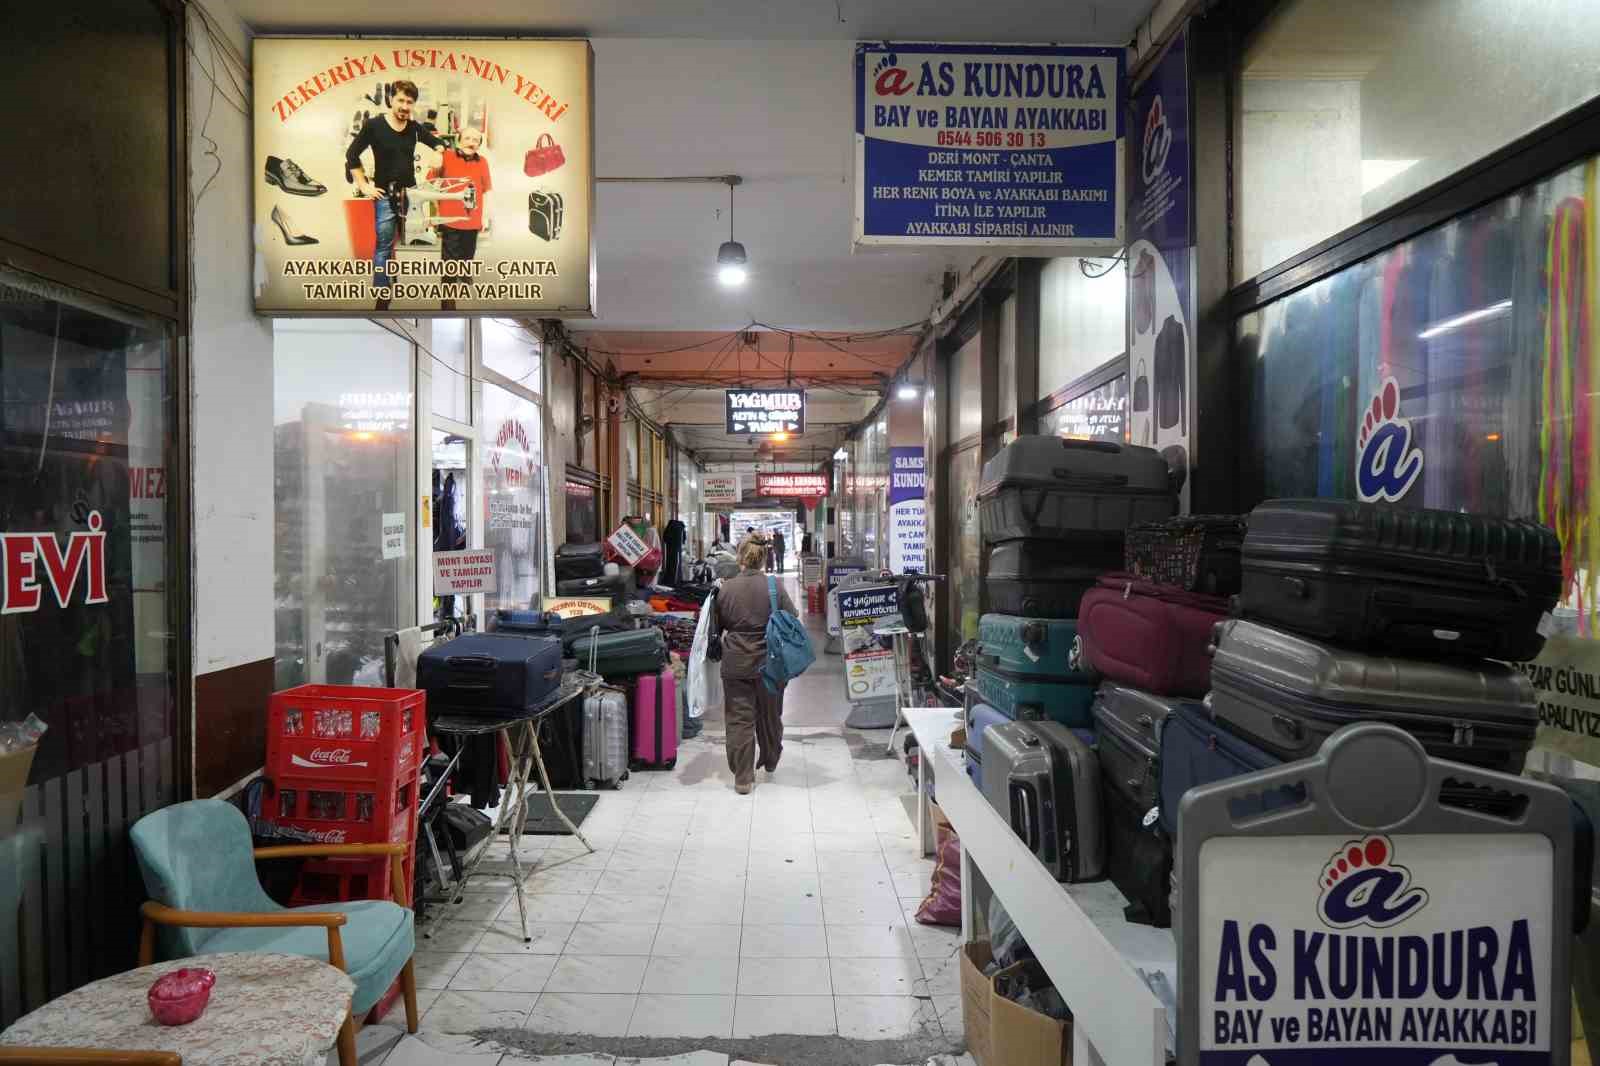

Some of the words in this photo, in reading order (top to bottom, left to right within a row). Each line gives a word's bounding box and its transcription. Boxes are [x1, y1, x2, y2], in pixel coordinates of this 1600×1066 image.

[271, 56, 386, 122] ZEKERİYA
[392, 49, 511, 84] USTA'NIN
[511, 75, 569, 122] YERİ
[916, 62, 954, 97] AS
[964, 62, 1106, 99] KUNDURA
[874, 104, 911, 128] BAY
[917, 108, 939, 128] ve
[945, 105, 1008, 129] BAYAN
[1015, 107, 1106, 131] AYAKKABI
[937, 131, 971, 146] 0544
[976, 132, 1002, 147] 506
[1007, 132, 1024, 147] 30
[1030, 132, 1045, 148] 13
[928, 151, 959, 165] DERİ
[962, 152, 999, 165] MONT
[1011, 153, 1053, 168] ÇANTA
[918, 169, 962, 182] KEMER
[966, 168, 1010, 183] TAMİRİ
[1014, 171, 1064, 184] YAPILIR
[872, 186, 901, 200] HER
[903, 187, 938, 200] RENK
[942, 187, 975, 200] BOYA
[979, 191, 992, 200] ve
[994, 189, 1059, 201] AYAKKABI
[1062, 189, 1108, 202] BAKIMI
[935, 204, 970, 218] İTİNA
[974, 204, 994, 218] İLE
[997, 206, 1047, 219] YAPILIR
[906, 222, 971, 235] AYAKKABI
[974, 220, 1028, 238] SİPARİŞİ
[1030, 223, 1075, 236] ALINIR
[283, 261, 372, 276] AYAKKABI
[387, 258, 482, 276] DERİMONT
[497, 261, 557, 280] ÇANTA
[304, 280, 366, 299] TAMİRİ
[369, 287, 390, 299] ve
[394, 284, 469, 299] BOYAMA
[475, 284, 542, 299] YAPILIR
[437, 556, 461, 567] MONT
[440, 569, 450, 577] VE
[1214, 920, 1278, 1002] AS
[1293, 919, 1537, 1002] KUNDURA
[1214, 1009, 1263, 1044] BAY
[1270, 1016, 1300, 1043] ve
[1307, 1007, 1392, 1043] BAYAN
[1399, 1007, 1536, 1045] AYAKKABI
